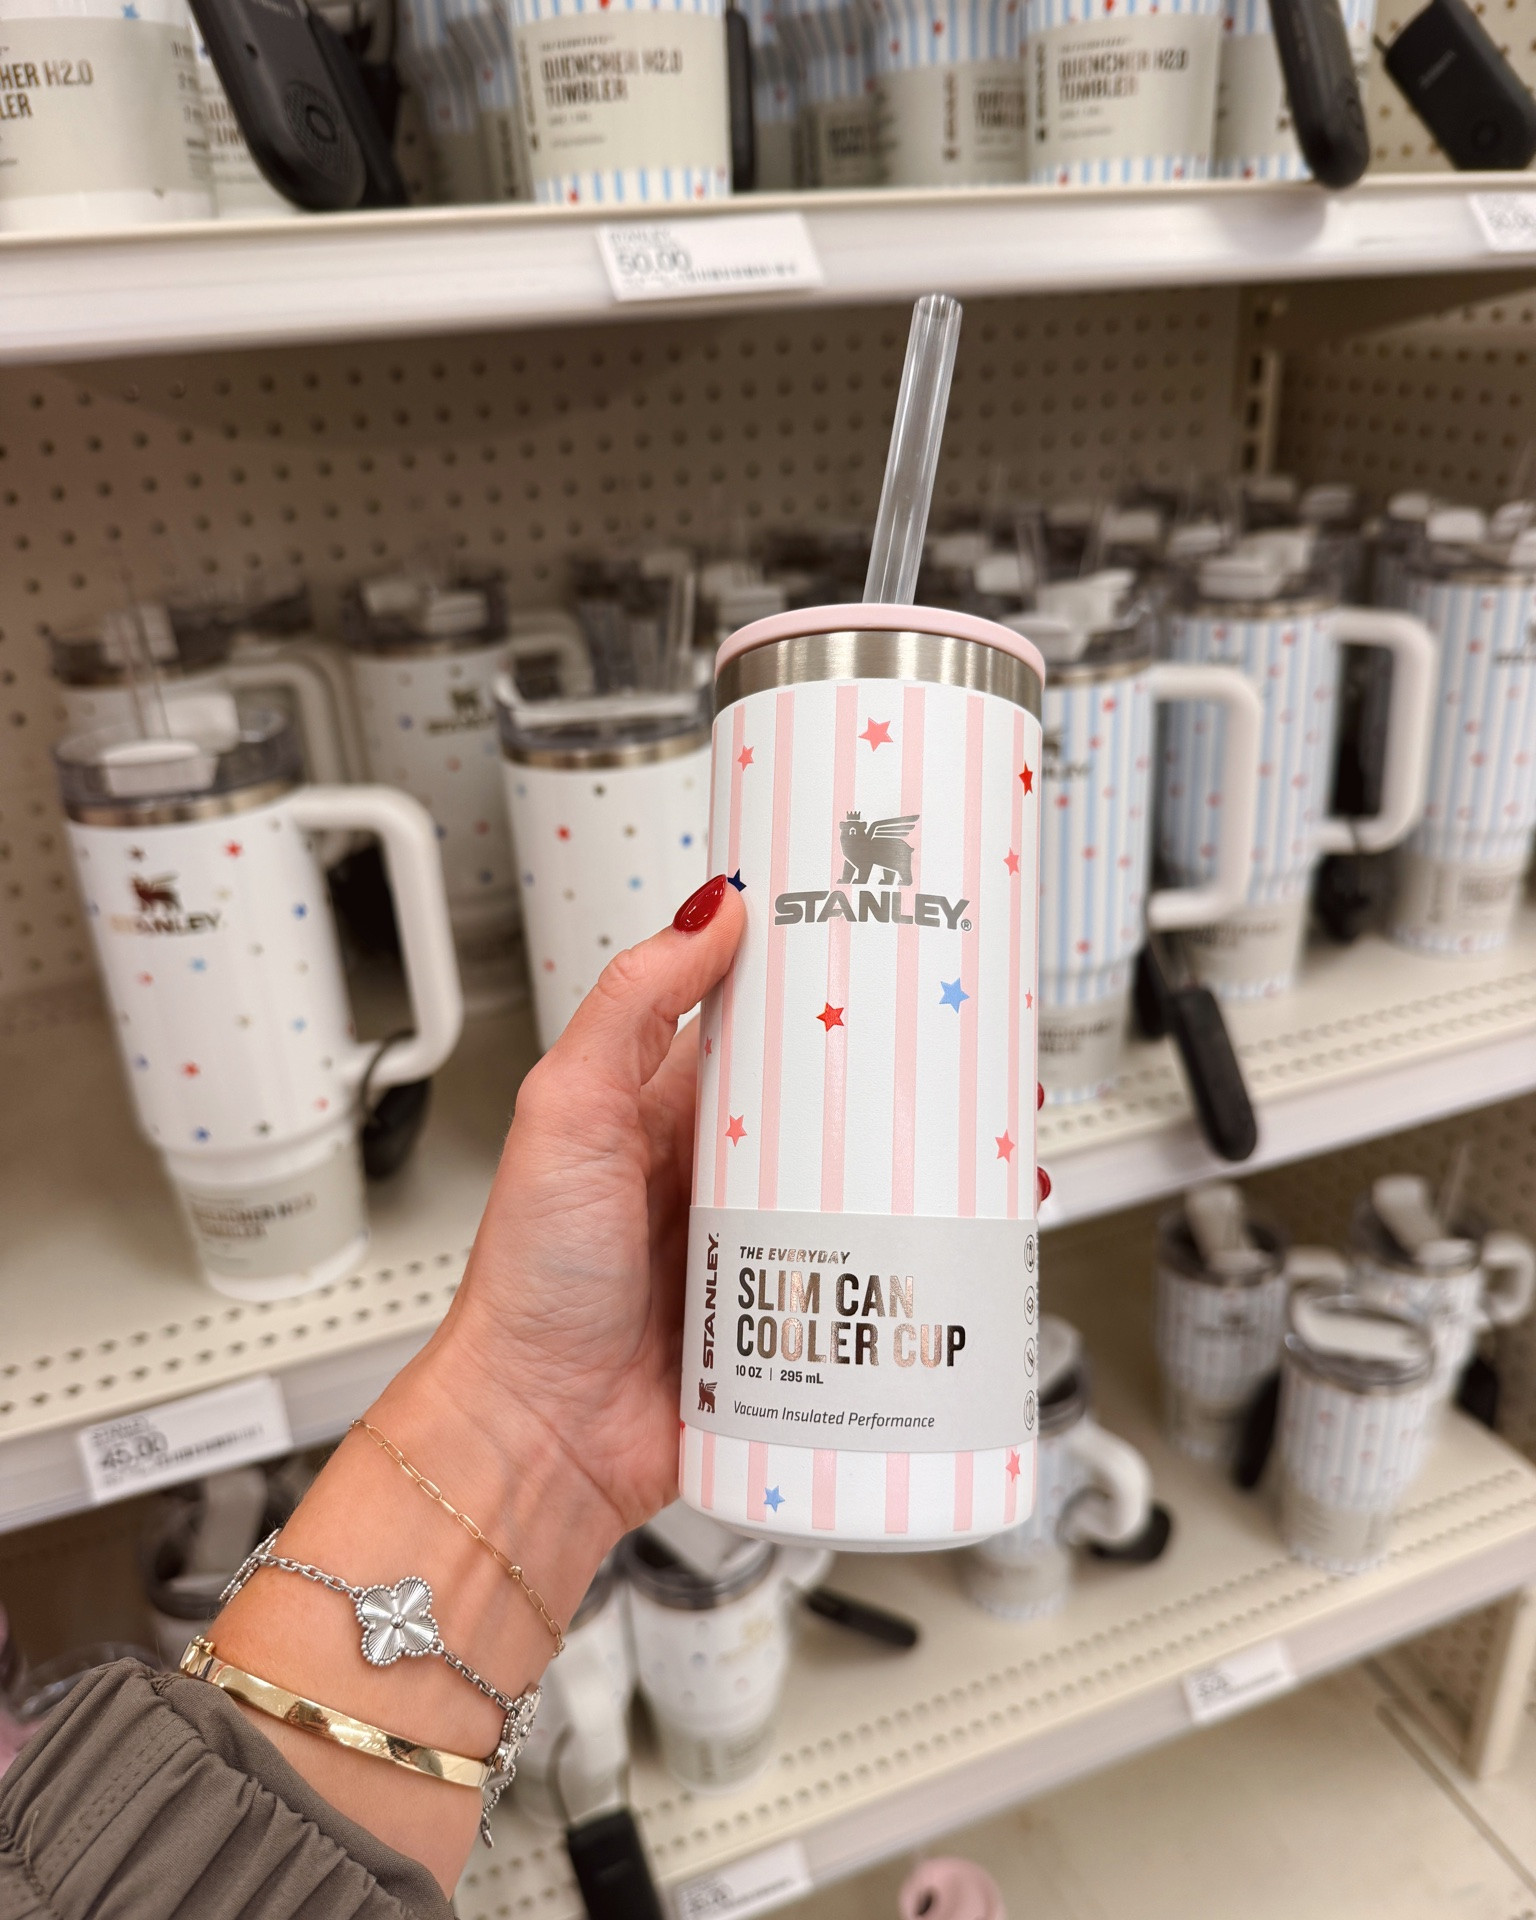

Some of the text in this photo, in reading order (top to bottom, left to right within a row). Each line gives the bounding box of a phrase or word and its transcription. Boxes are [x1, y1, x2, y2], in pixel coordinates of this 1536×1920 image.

[740, 1246, 851, 1264] THE EVERYDAY
[738, 1267, 914, 1318] SLIM CAN
[736, 1313, 966, 1368] COOLER CUP
[735, 1365, 824, 1384] 10 OZ 295 mL
[734, 1400, 935, 1429] Vacuum Insulated Performance
